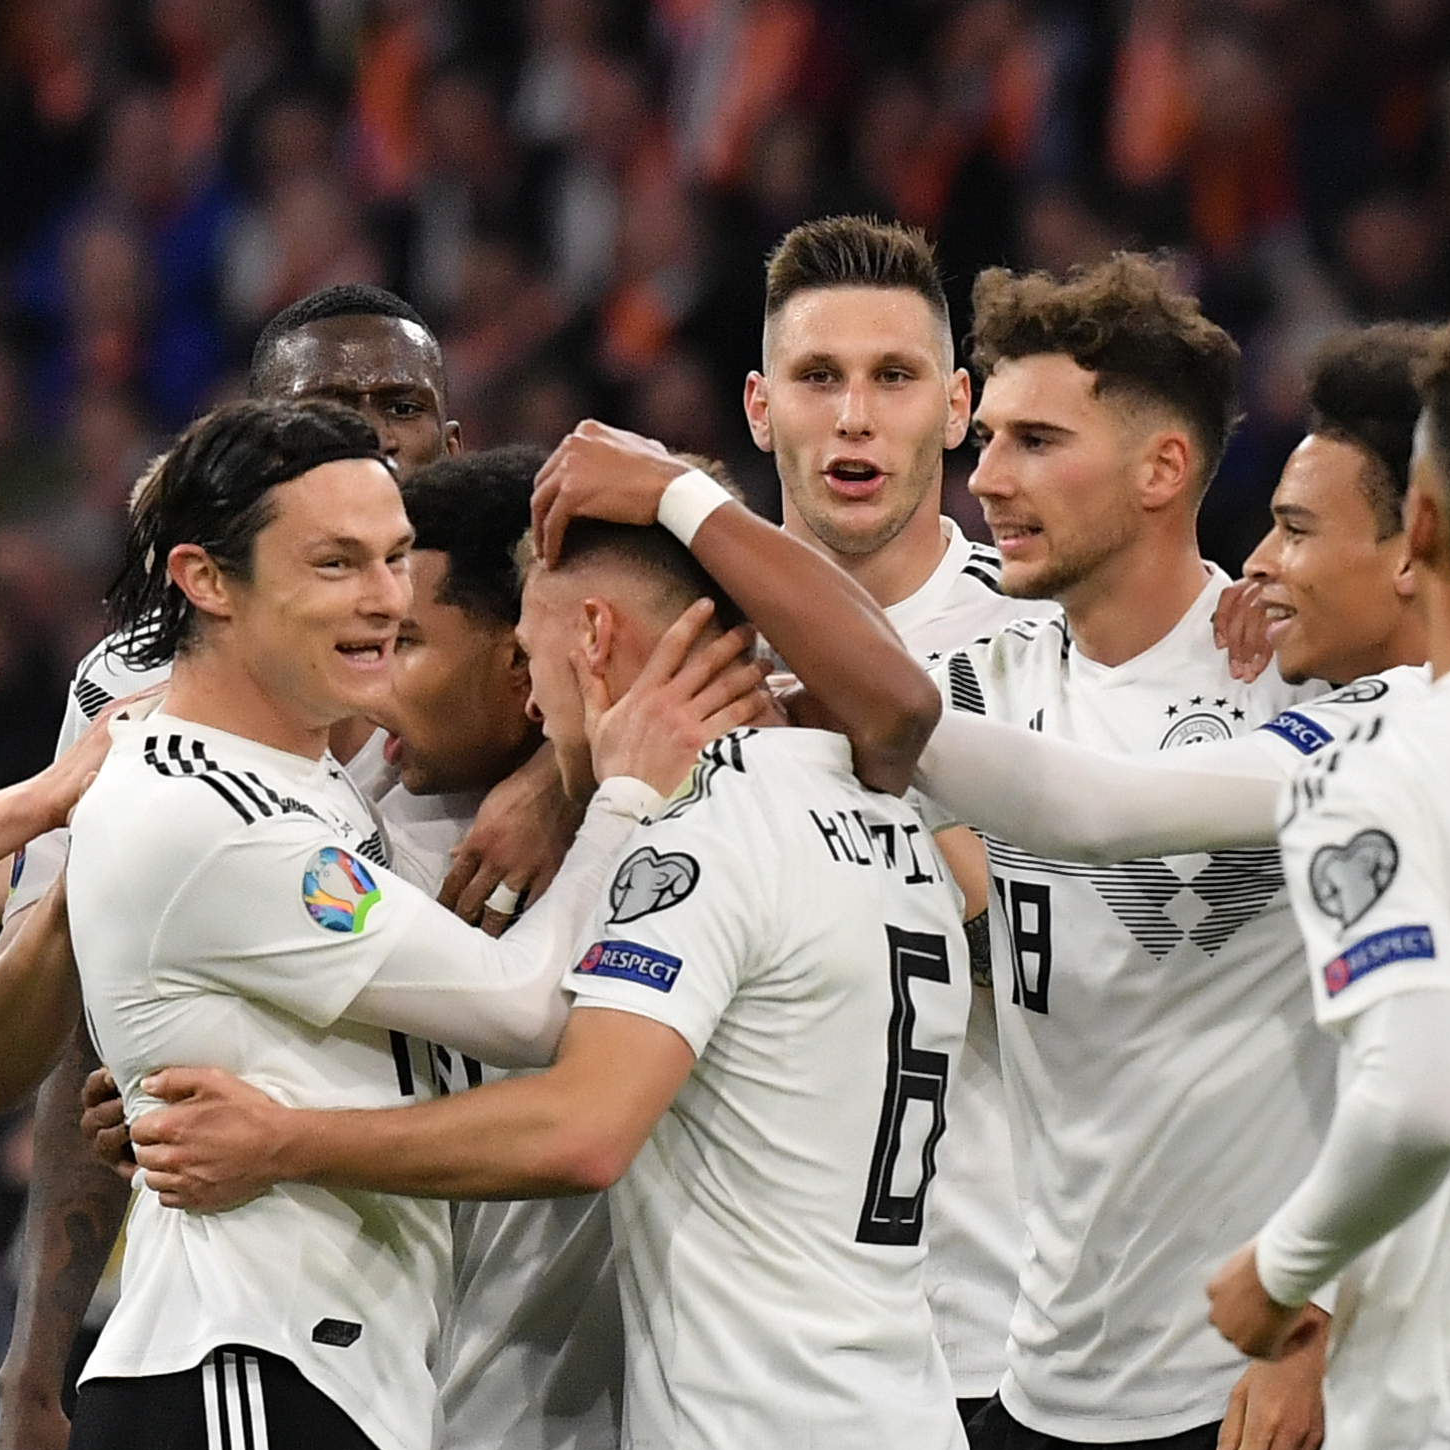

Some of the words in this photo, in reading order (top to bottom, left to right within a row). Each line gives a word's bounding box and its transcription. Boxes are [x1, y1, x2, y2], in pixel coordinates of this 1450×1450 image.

[1273, 714, 1326, 749] SPECT
[599, 949, 678, 982] RESPECT
[854, 923, 952, 1246] 6
